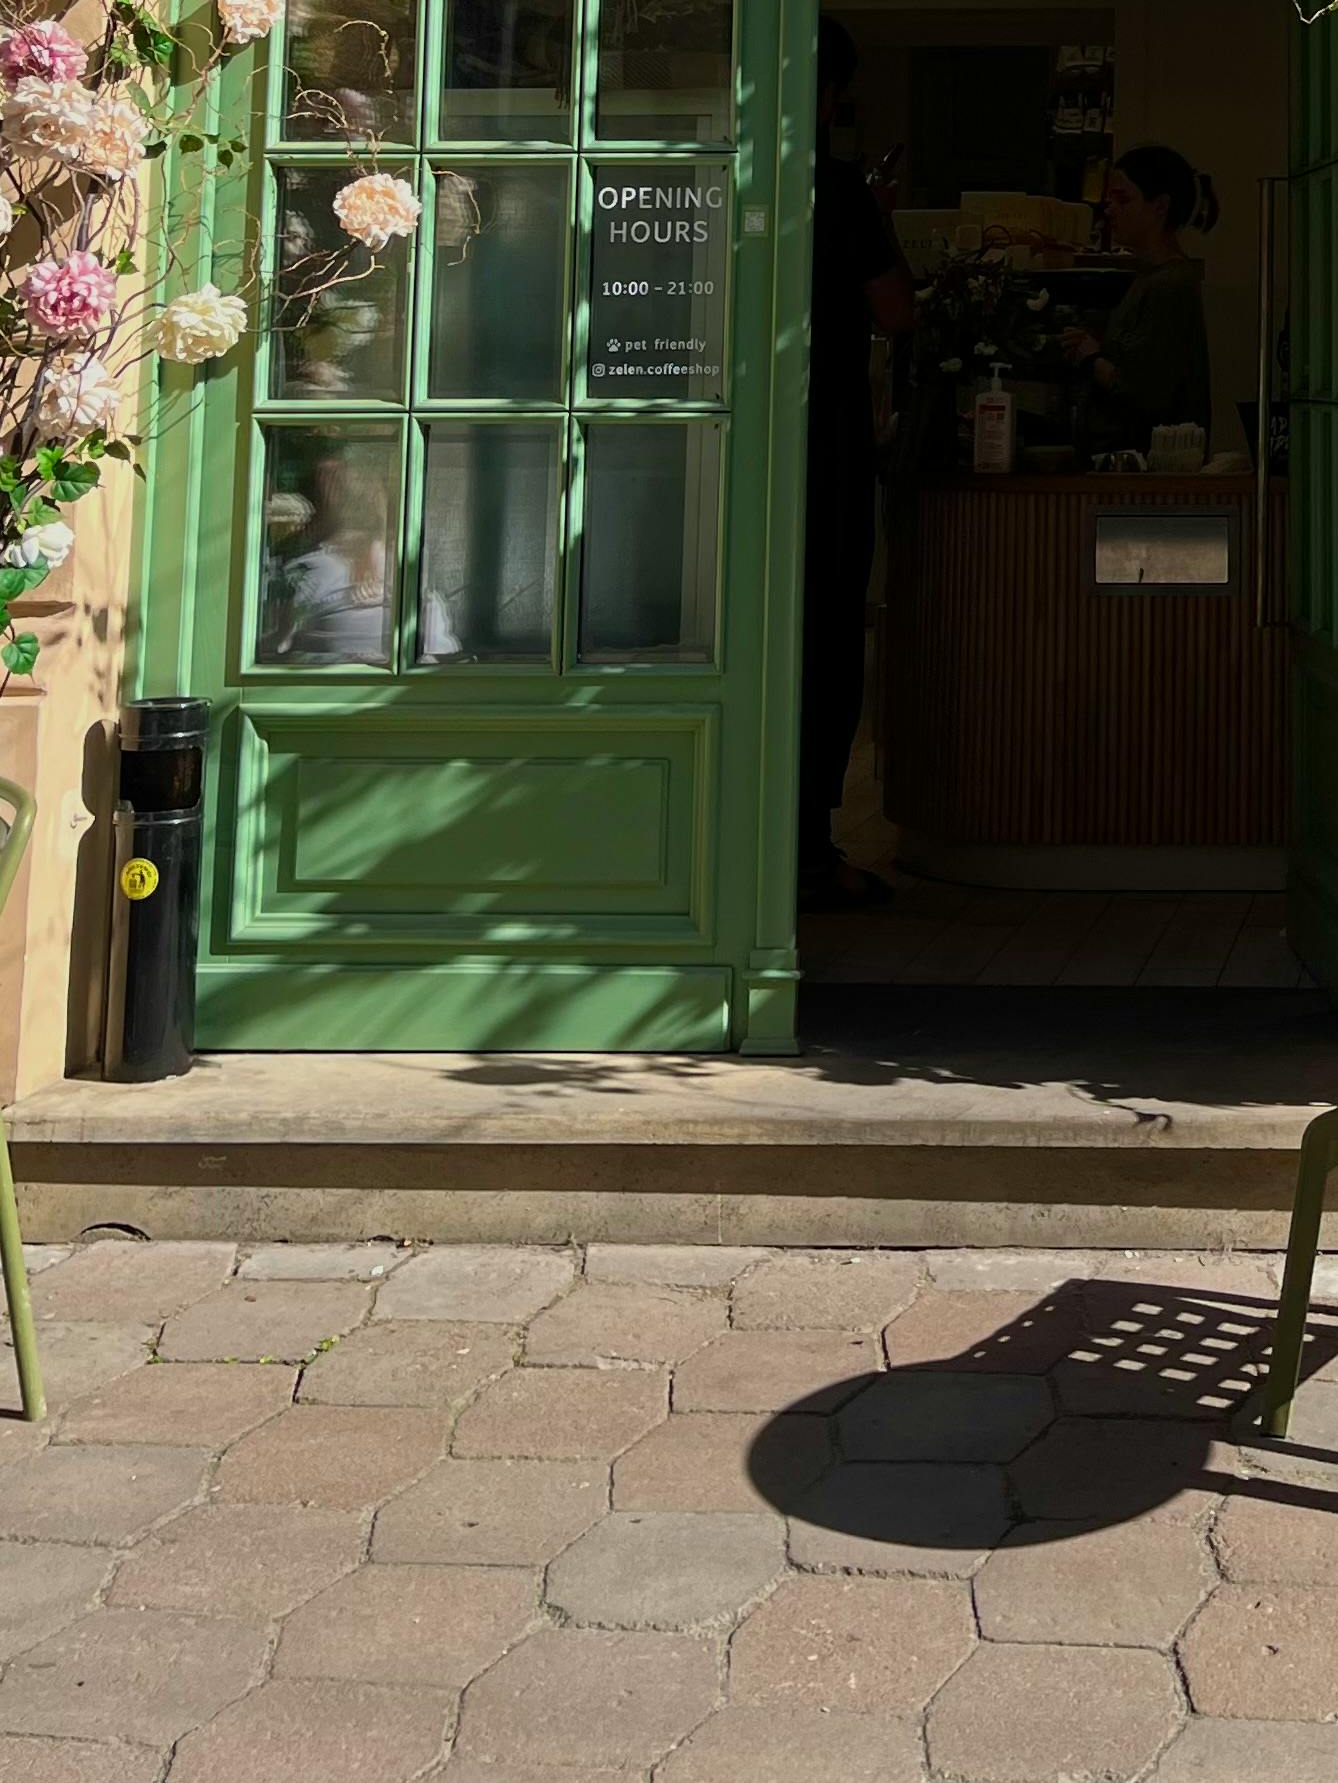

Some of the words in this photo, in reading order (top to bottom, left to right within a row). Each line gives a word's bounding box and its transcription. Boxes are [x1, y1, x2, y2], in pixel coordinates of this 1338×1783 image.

[598, 186, 723, 209] OPENING
[609, 220, 709, 243] HOURS
[602, 281, 649, 296] 10:00
[667, 280, 714, 295] 21:00
[625, 340, 647, 353] pet
[654, 338, 706, 353] friendly
[608, 363, 720, 377] zelen.coffeeshop
